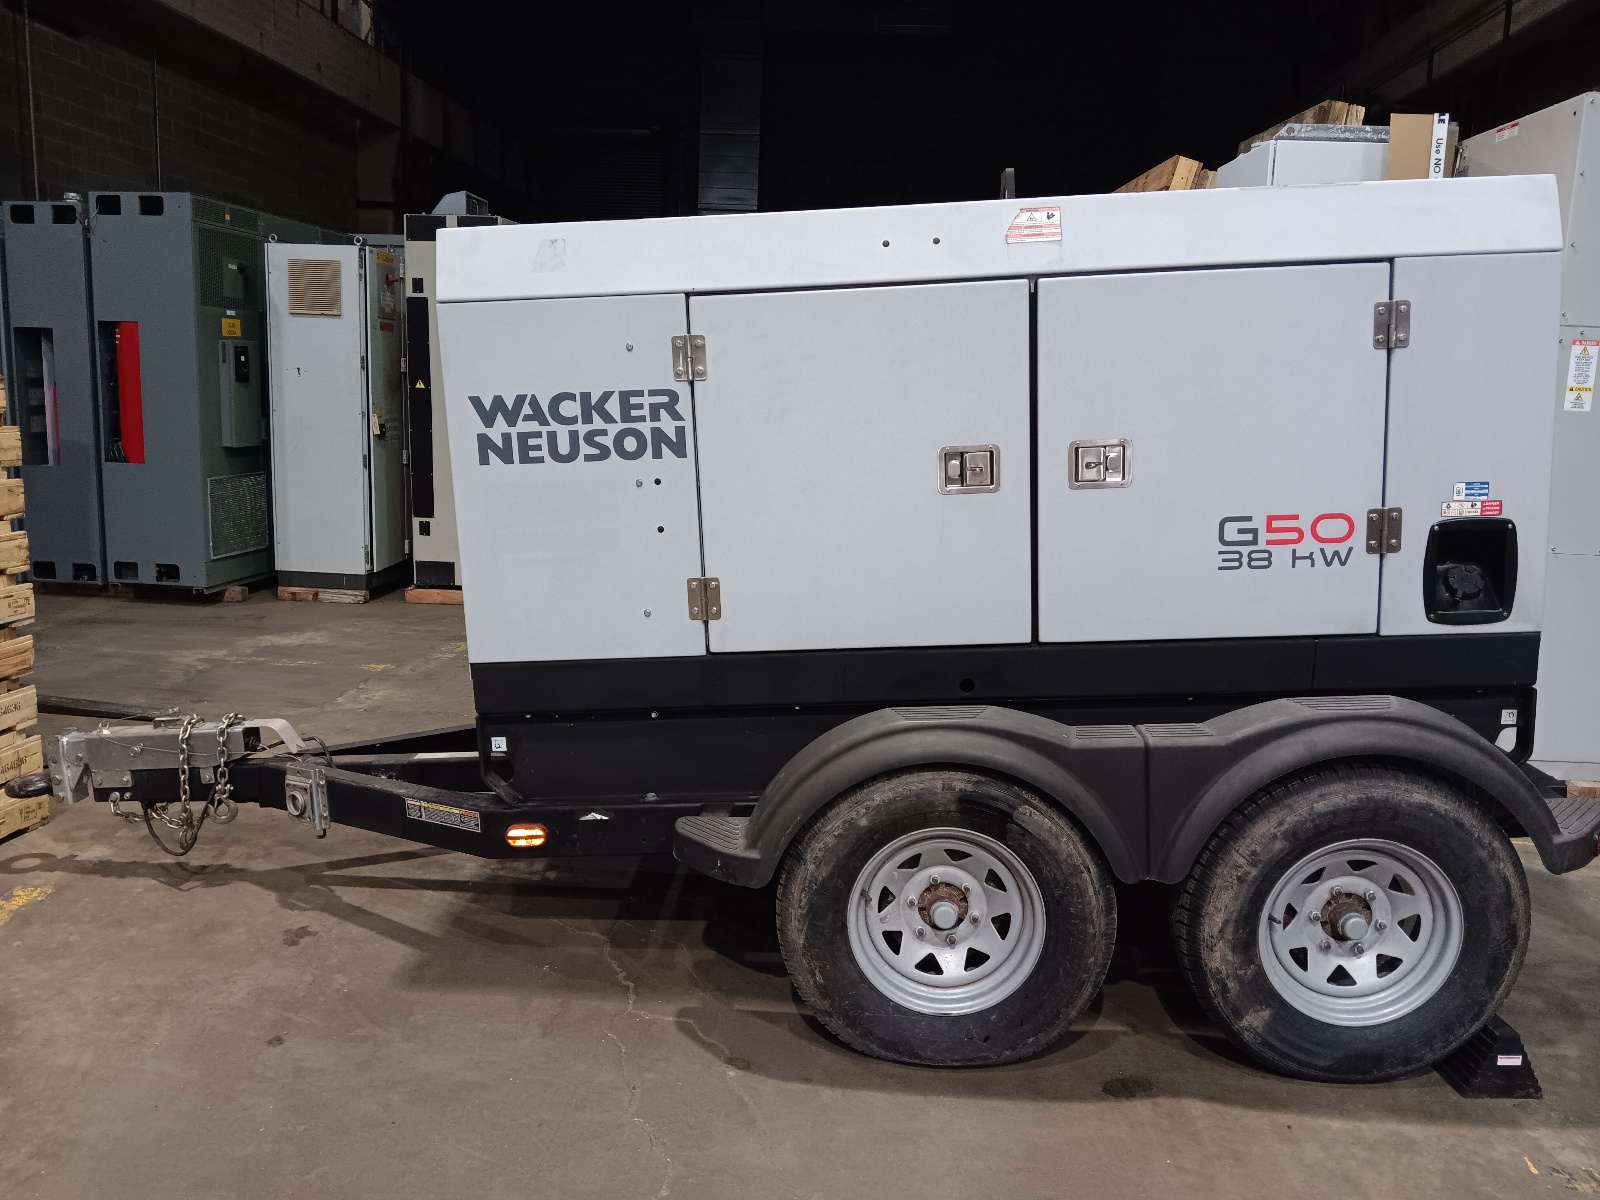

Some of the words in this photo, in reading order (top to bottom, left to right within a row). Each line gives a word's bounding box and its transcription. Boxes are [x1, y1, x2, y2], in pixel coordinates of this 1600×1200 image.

[1435, 138, 1444, 154] Use
[1434, 158, 1442, 174] NO
[467, 388, 686, 428] WACKER
[476, 425, 688, 466] NEUSON
[1218, 512, 1356, 547] G50
[1217, 549, 1273, 570] 38
